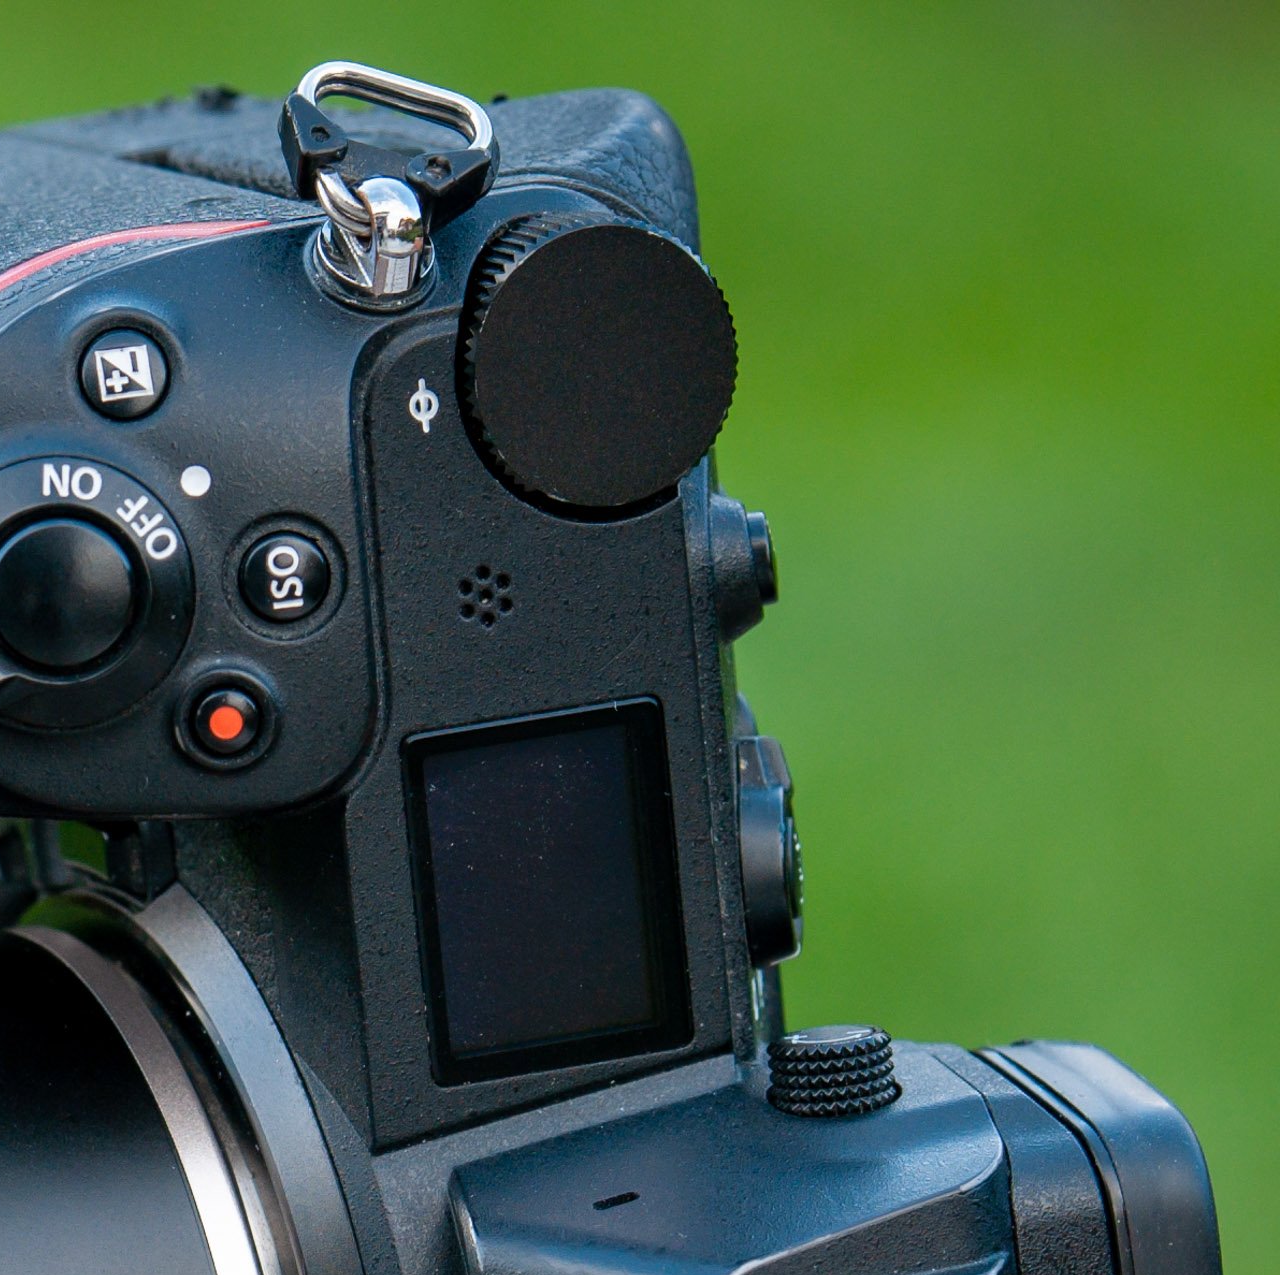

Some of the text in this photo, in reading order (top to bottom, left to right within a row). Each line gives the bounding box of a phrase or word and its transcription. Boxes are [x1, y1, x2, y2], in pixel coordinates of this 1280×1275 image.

[42, 463, 103, 500] ON
[115, 495, 178, 561] OFF
[268, 546, 304, 610] ISO
